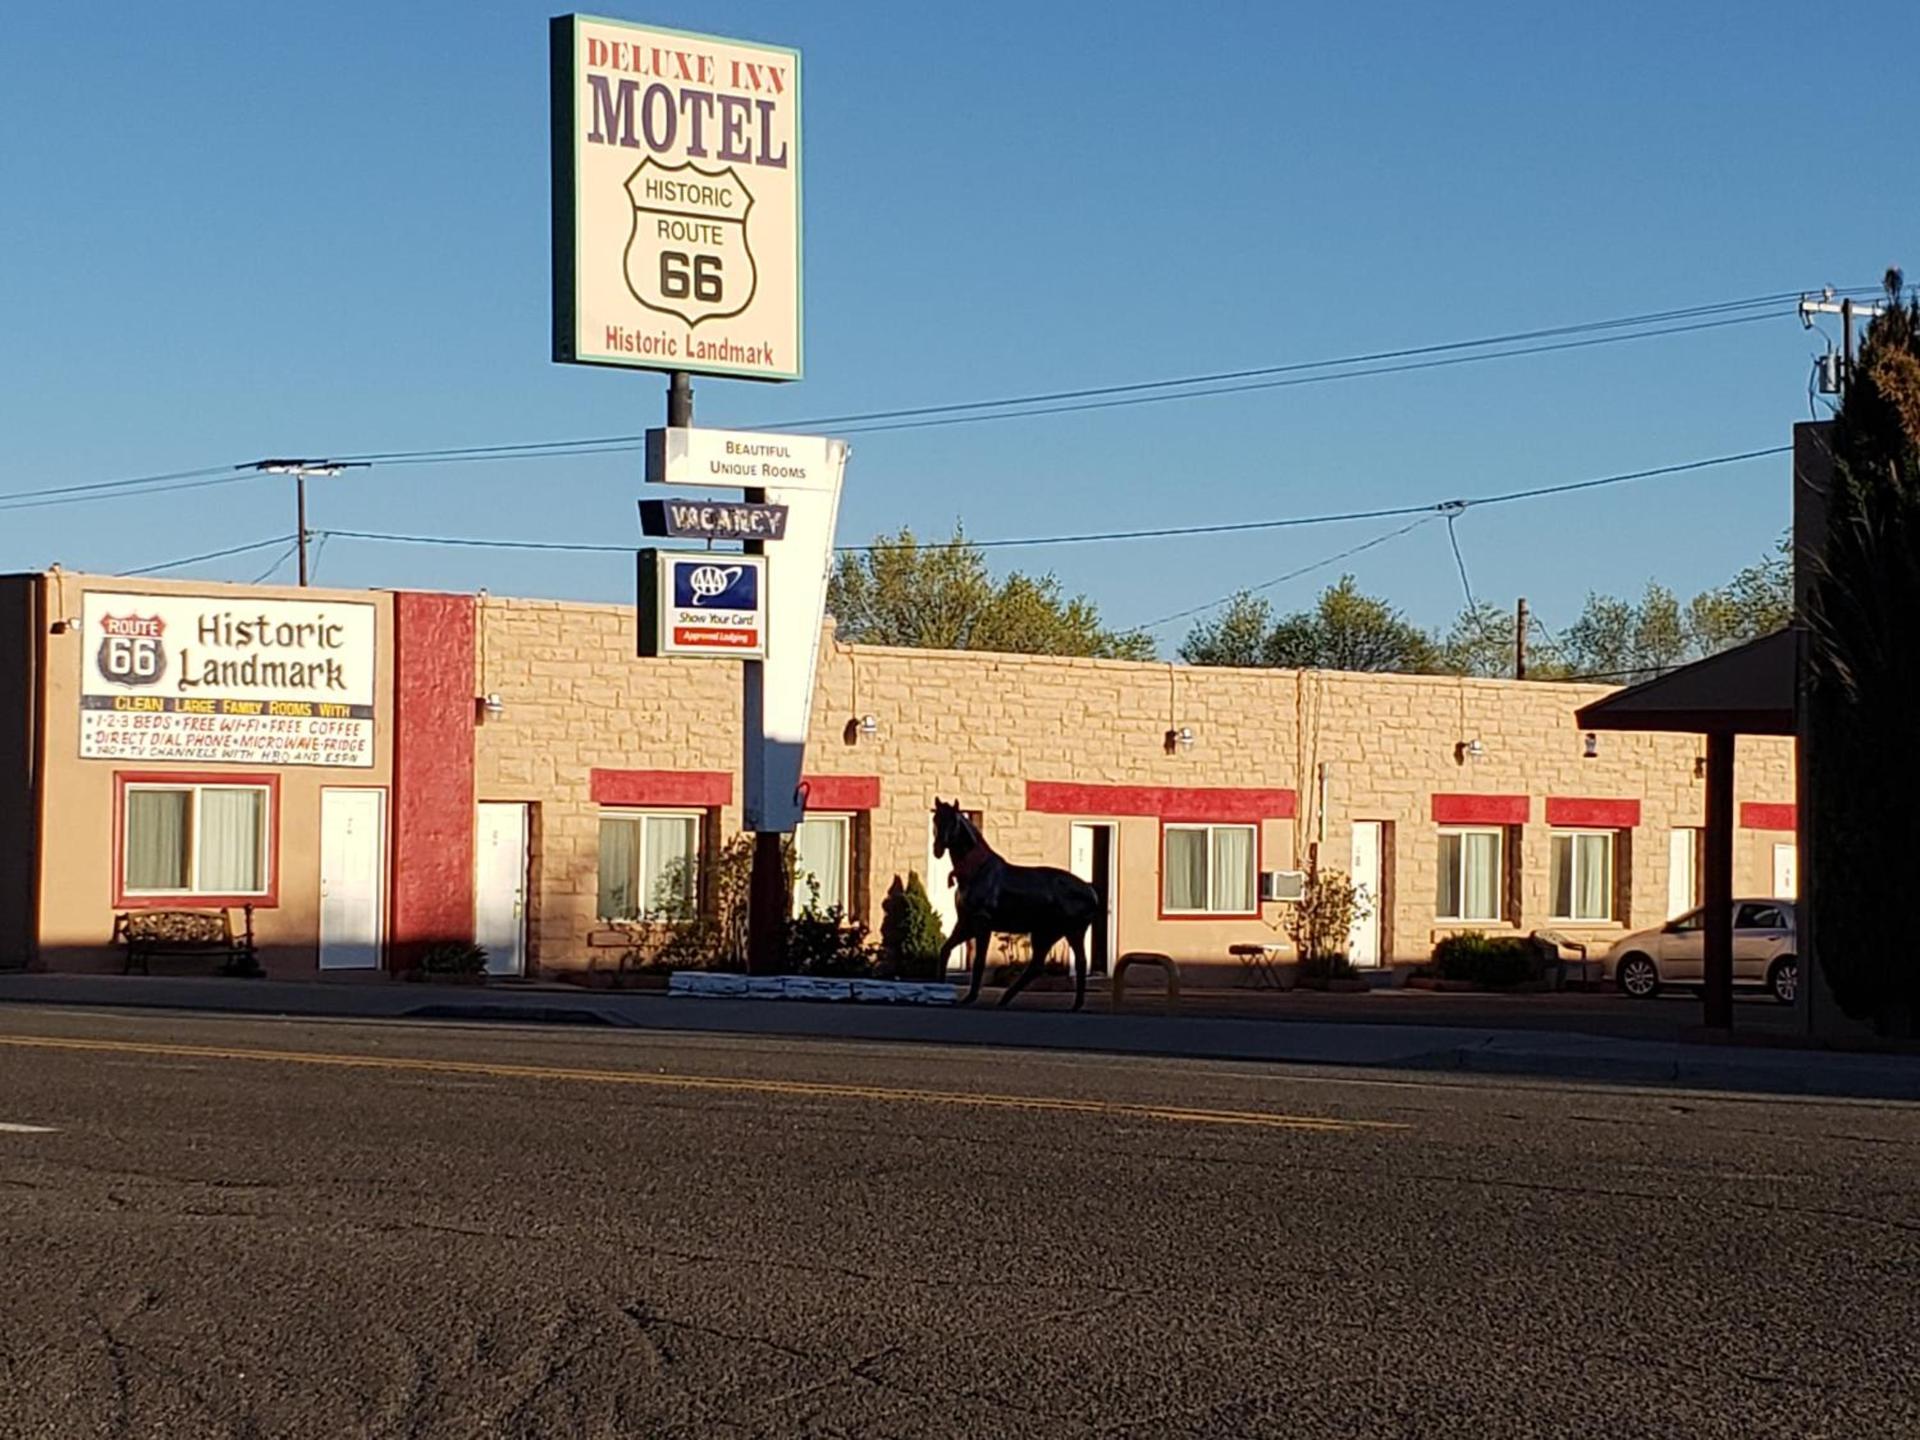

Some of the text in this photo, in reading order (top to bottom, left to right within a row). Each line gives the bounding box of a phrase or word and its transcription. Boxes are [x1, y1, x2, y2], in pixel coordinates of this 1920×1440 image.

[587, 38, 786, 95] DELUXE INN
[587, 74, 787, 169] MOTEL
[646, 179, 733, 208] HISTORIC
[657, 219, 723, 246] ROUTE
[660, 250, 723, 303] 66
[606, 325, 774, 366] Historic Landmark
[726, 441, 791, 458] BEAUTIFUL
[710, 461, 806, 479] UNIQUE ROOMS
[671, 505, 782, 535] VACANCY
[108, 617, 159, 636] ROUTE
[198, 612, 344, 649] Historic
[679, 612, 753, 625] Show Your Card
[109, 638, 155, 676] 66
[178, 648, 347, 691] Landmark
[115, 696, 350, 718] CLEAN LARGE FAMILY ROOMS WITH
[95, 731, 147, 745] DIRECT
[150, 732, 181, 746] DIAL
[186, 734, 232, 748] PHONE
[133, 715, 172, 730] BEDS
[182, 717, 216, 731] FREE
[269, 719, 302, 733] FREE
[309, 721, 360, 736] COFFEE
